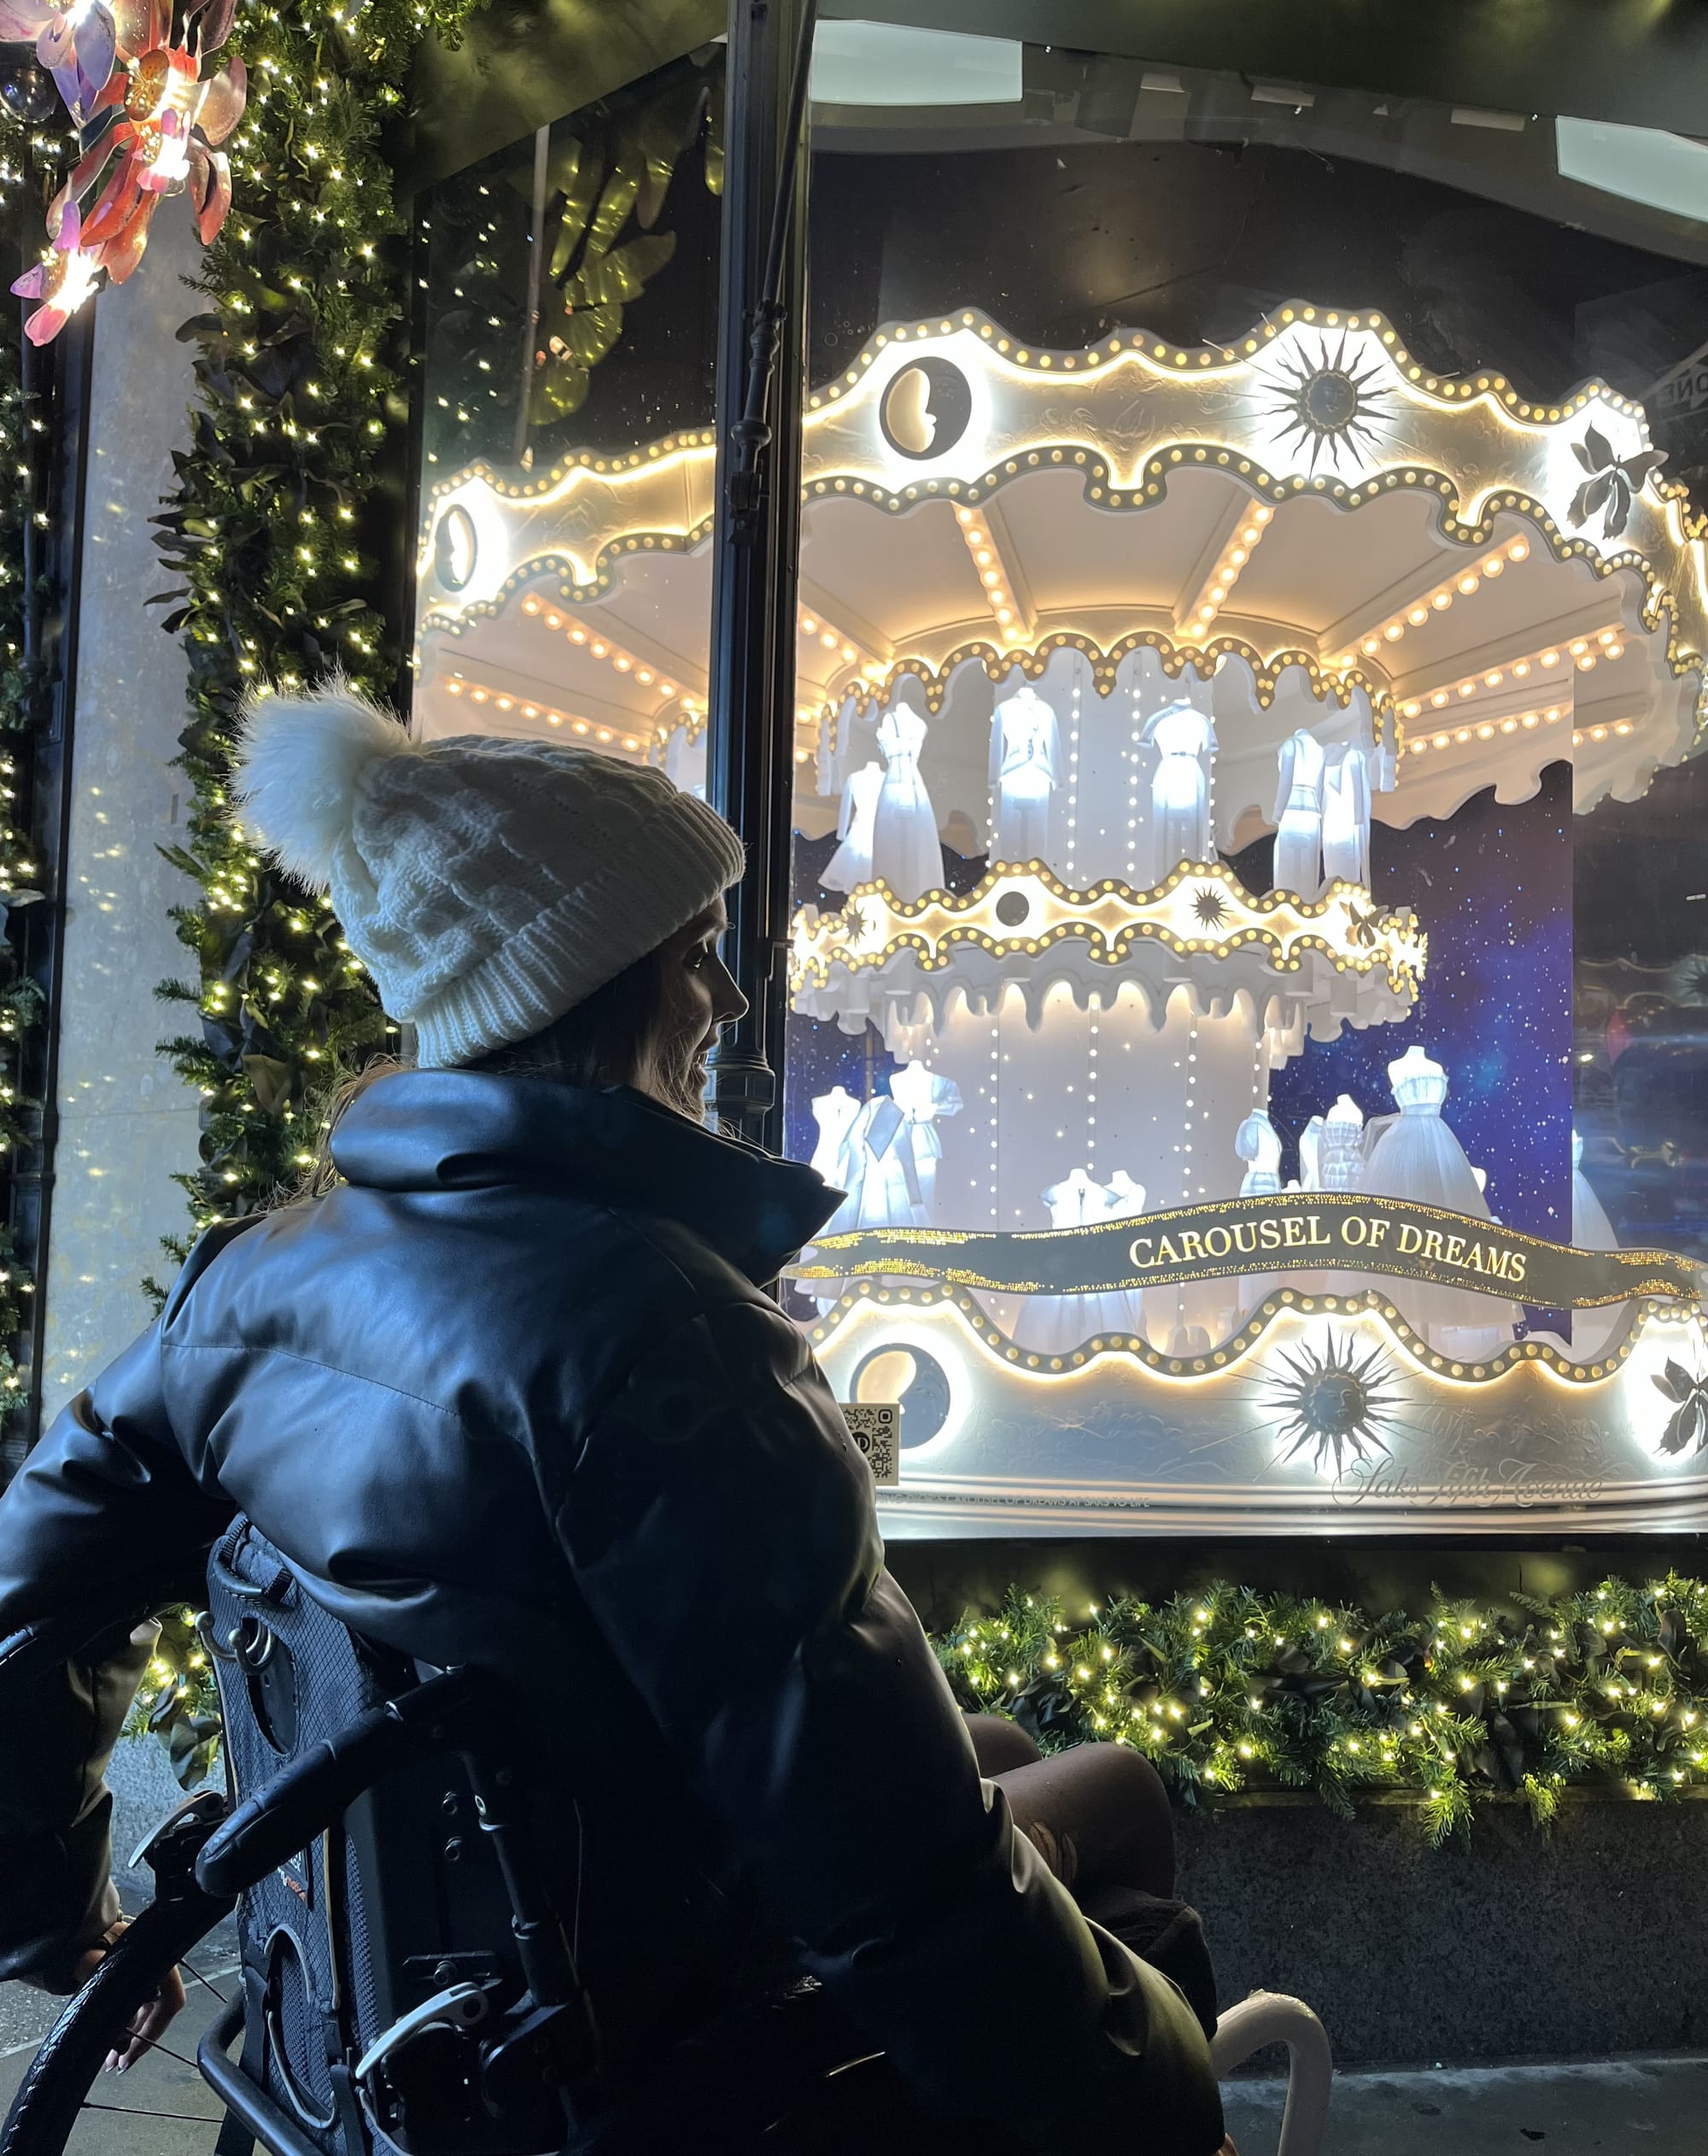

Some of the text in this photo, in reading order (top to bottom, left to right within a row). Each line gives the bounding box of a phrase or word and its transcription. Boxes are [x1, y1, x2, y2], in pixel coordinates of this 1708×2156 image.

[1129, 1216, 1527, 1283] CAROUSEL OF DREAMS
[1024, 1497, 1067, 1506] DREAMS
[1068, 1497, 1081, 1506] AT
[1085, 1497, 1109, 1507] SAKS
[1112, 1497, 1127, 1507] TO
[1130, 1497, 1150, 1508] LIFE
[1332, 1457, 1603, 1508] Saks Fifth Avenue
